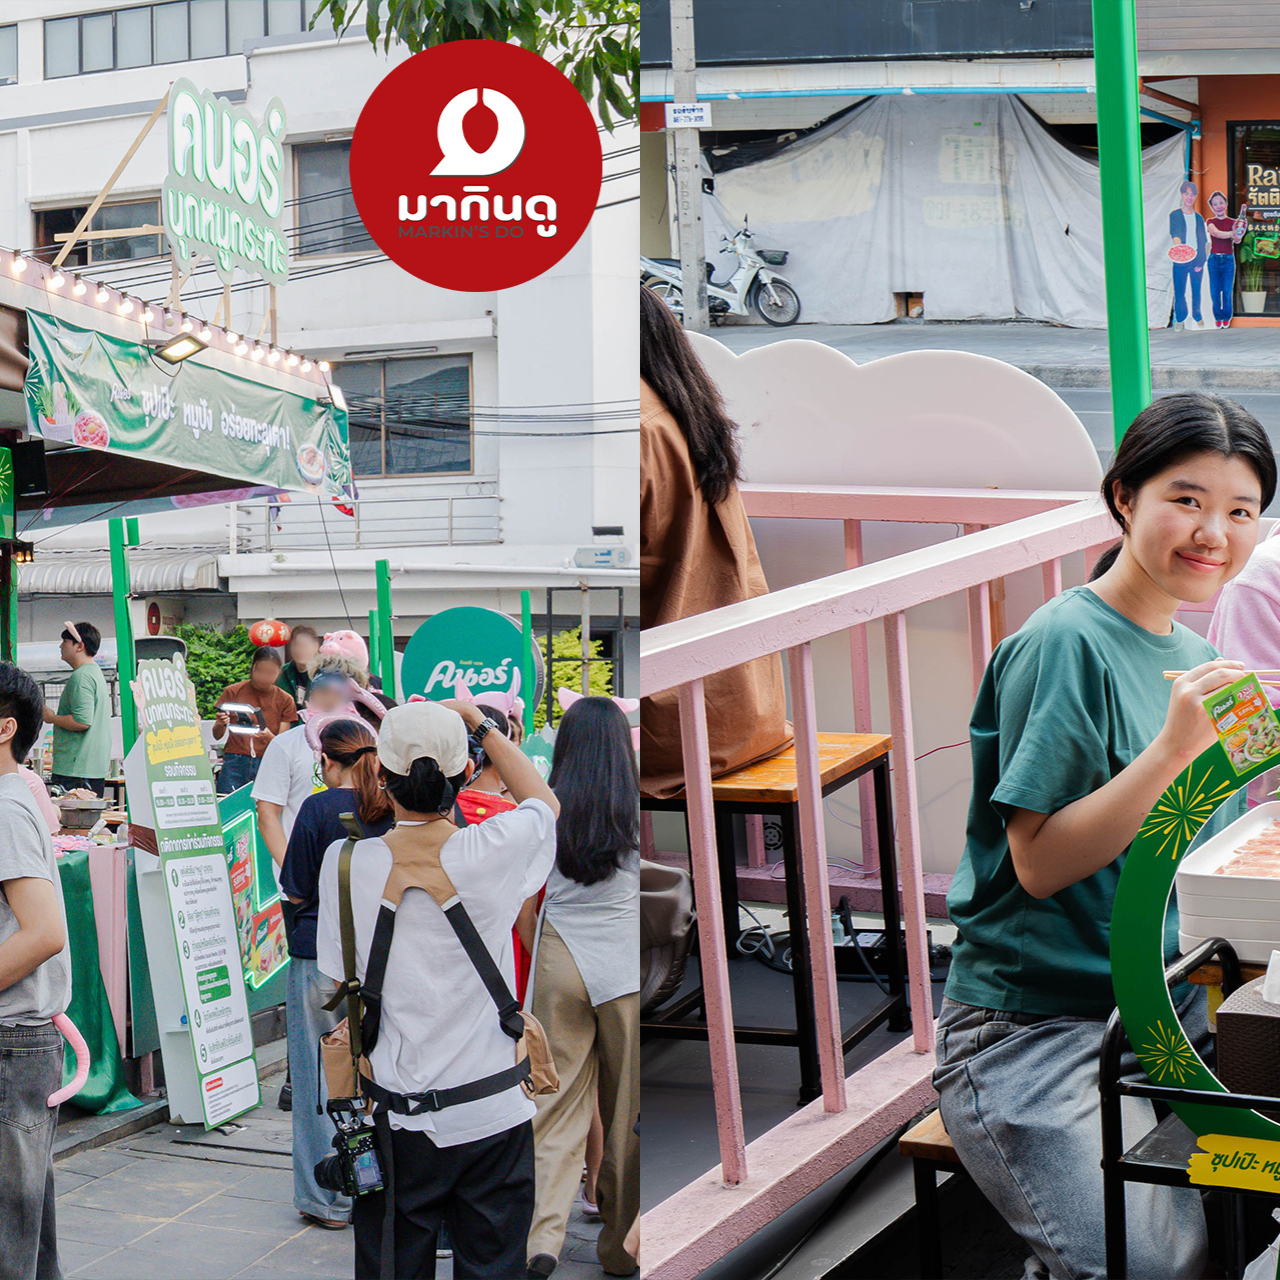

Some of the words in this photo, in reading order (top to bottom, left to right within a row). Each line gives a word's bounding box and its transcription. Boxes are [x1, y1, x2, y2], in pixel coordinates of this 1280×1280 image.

[172, 88, 285, 219] คนอร์
[167, 187, 288, 277] บุกหมูกระทะ
[141, 659, 187, 701] คนอร์
[423, 657, 513, 694] คนอร์
[1213, 695, 1234, 718] คนอร์
[1210, 1150, 1260, 1172] ซุปเป๊ะ
